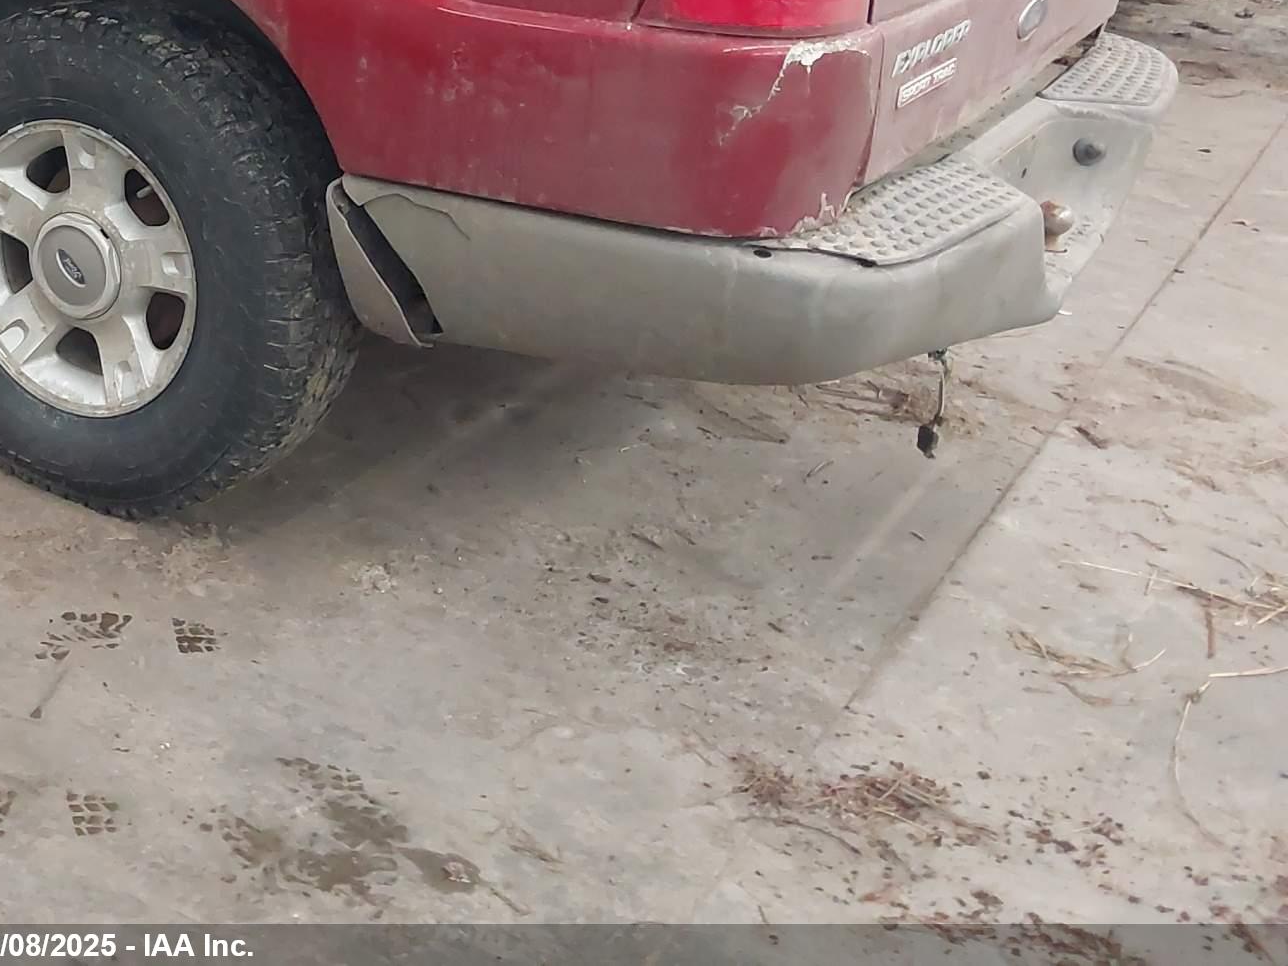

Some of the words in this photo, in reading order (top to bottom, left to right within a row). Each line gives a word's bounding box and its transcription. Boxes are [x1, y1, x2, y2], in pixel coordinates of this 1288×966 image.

[890, 19, 972, 79] EXPLORER
[902, 75, 933, 104] SPORT
[932, 62, 957, 85] TRAC
